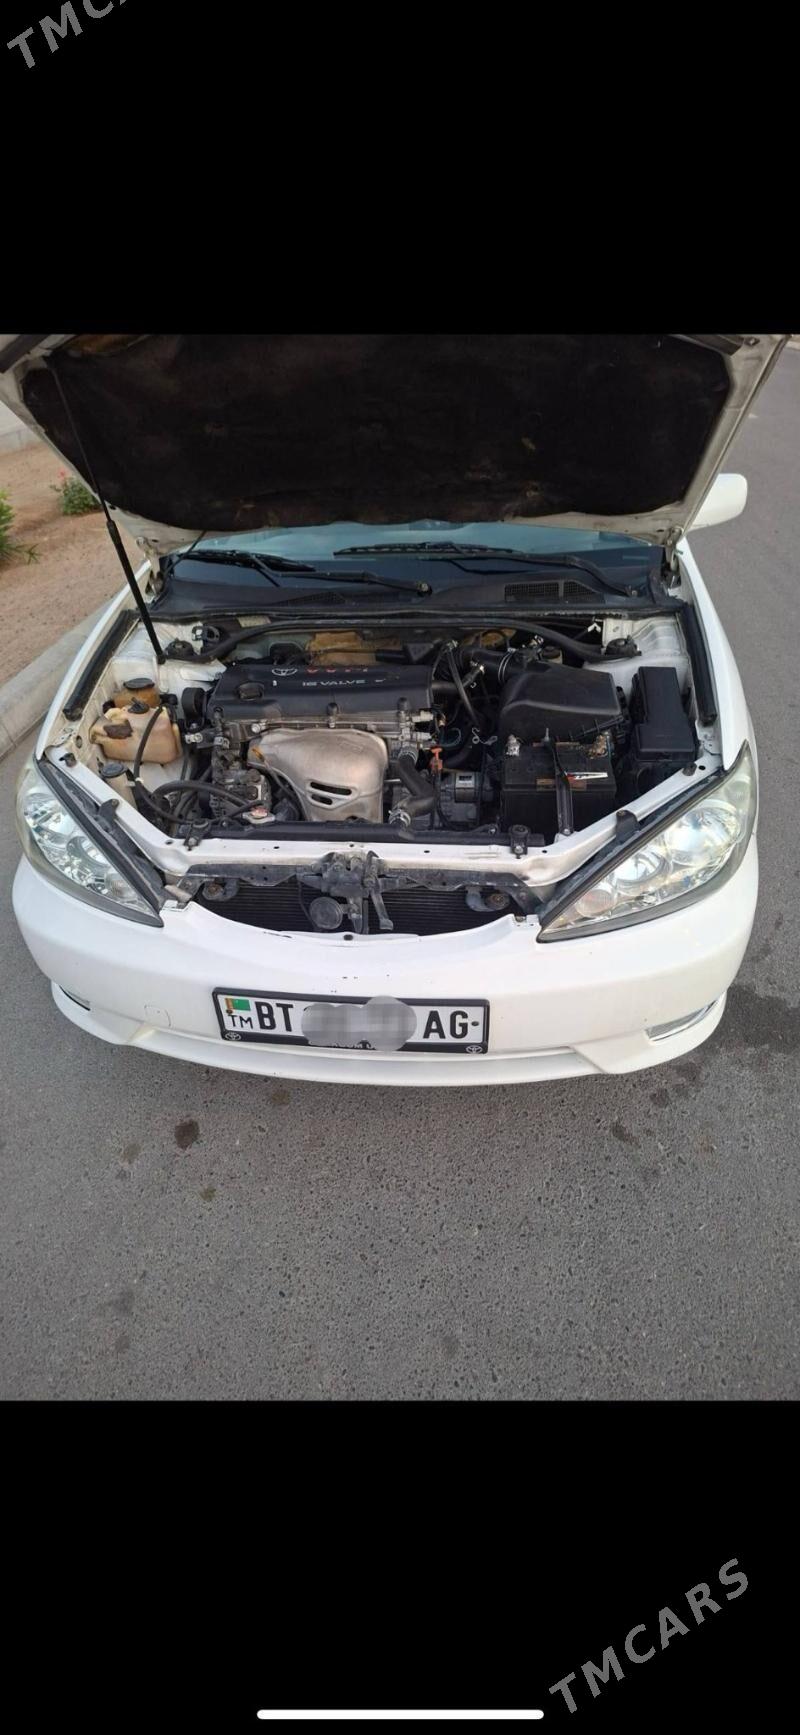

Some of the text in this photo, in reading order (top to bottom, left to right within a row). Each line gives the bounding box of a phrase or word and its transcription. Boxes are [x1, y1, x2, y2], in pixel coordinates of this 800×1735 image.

[228, 1014, 254, 1029] TM
[255, 1001, 294, 1032] BT
[423, 1010, 469, 1039] AG
